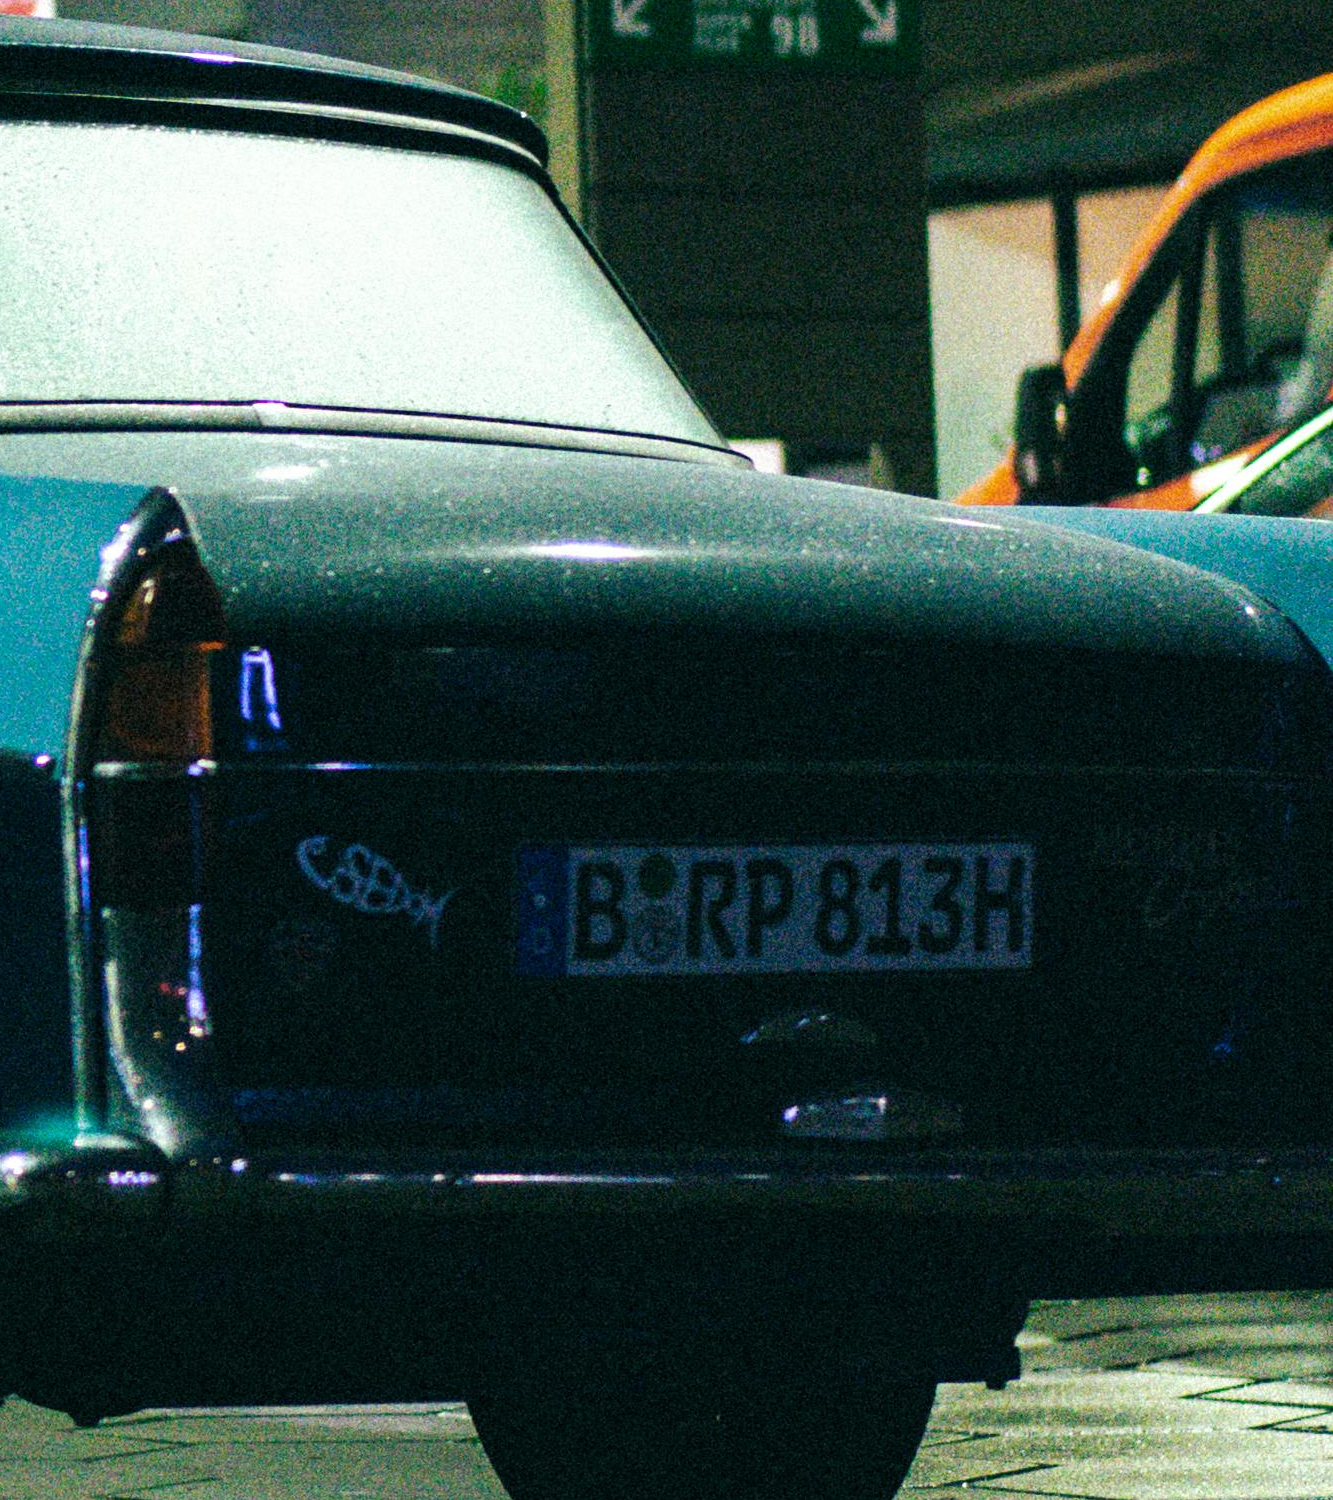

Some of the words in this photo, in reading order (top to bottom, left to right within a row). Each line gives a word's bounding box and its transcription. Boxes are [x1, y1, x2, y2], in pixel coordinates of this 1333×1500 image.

[573, 861, 626, 961] B
[686, 857, 794, 958] RP
[814, 856, 1023, 956] 813H
